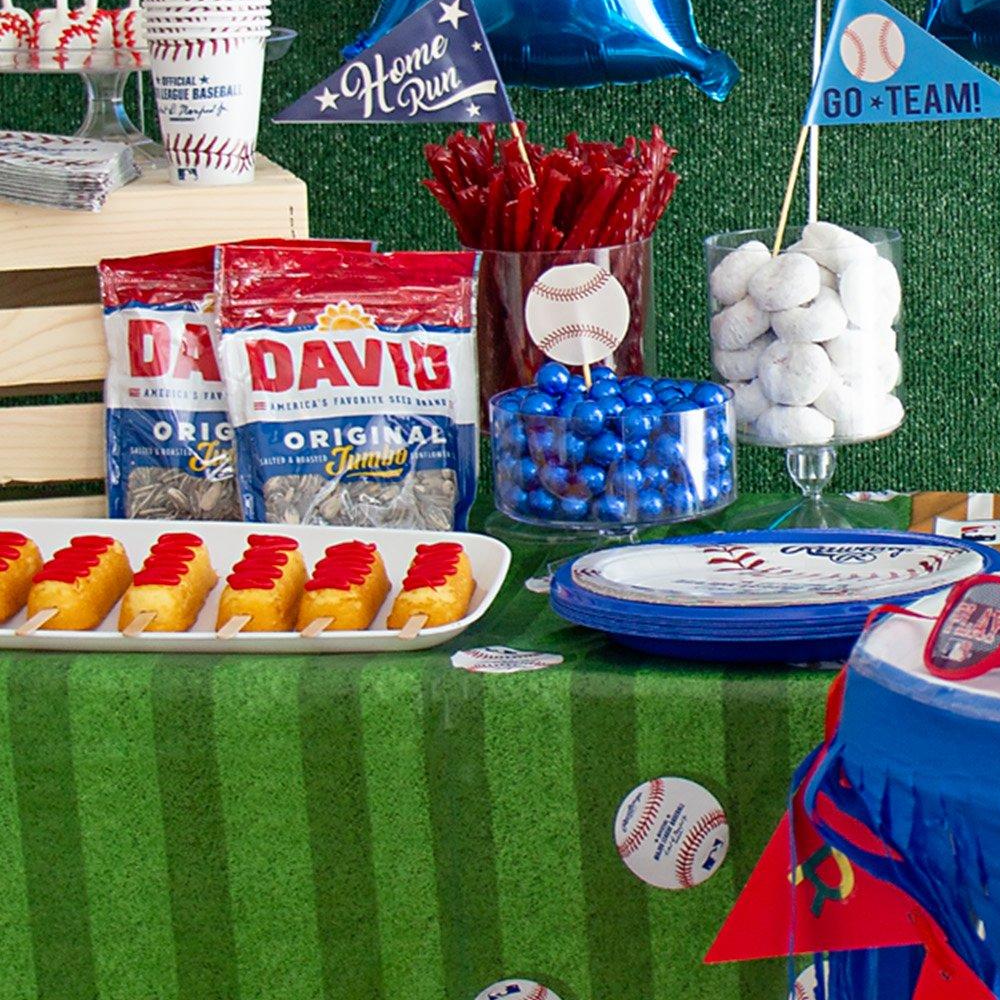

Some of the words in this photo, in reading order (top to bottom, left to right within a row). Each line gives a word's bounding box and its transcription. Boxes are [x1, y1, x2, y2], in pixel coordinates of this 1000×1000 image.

[161, 76, 197, 87] OFFICIAL
[340, 33, 449, 119] Home
[397, 65, 465, 117] Run
[822, 87, 862, 119] GO
[885, 81, 982, 116] TEAM!
[245, 337, 452, 393] DAVID
[283, 425, 448, 450] ORIGINAL
[325, 444, 408, 478] Jumbo
